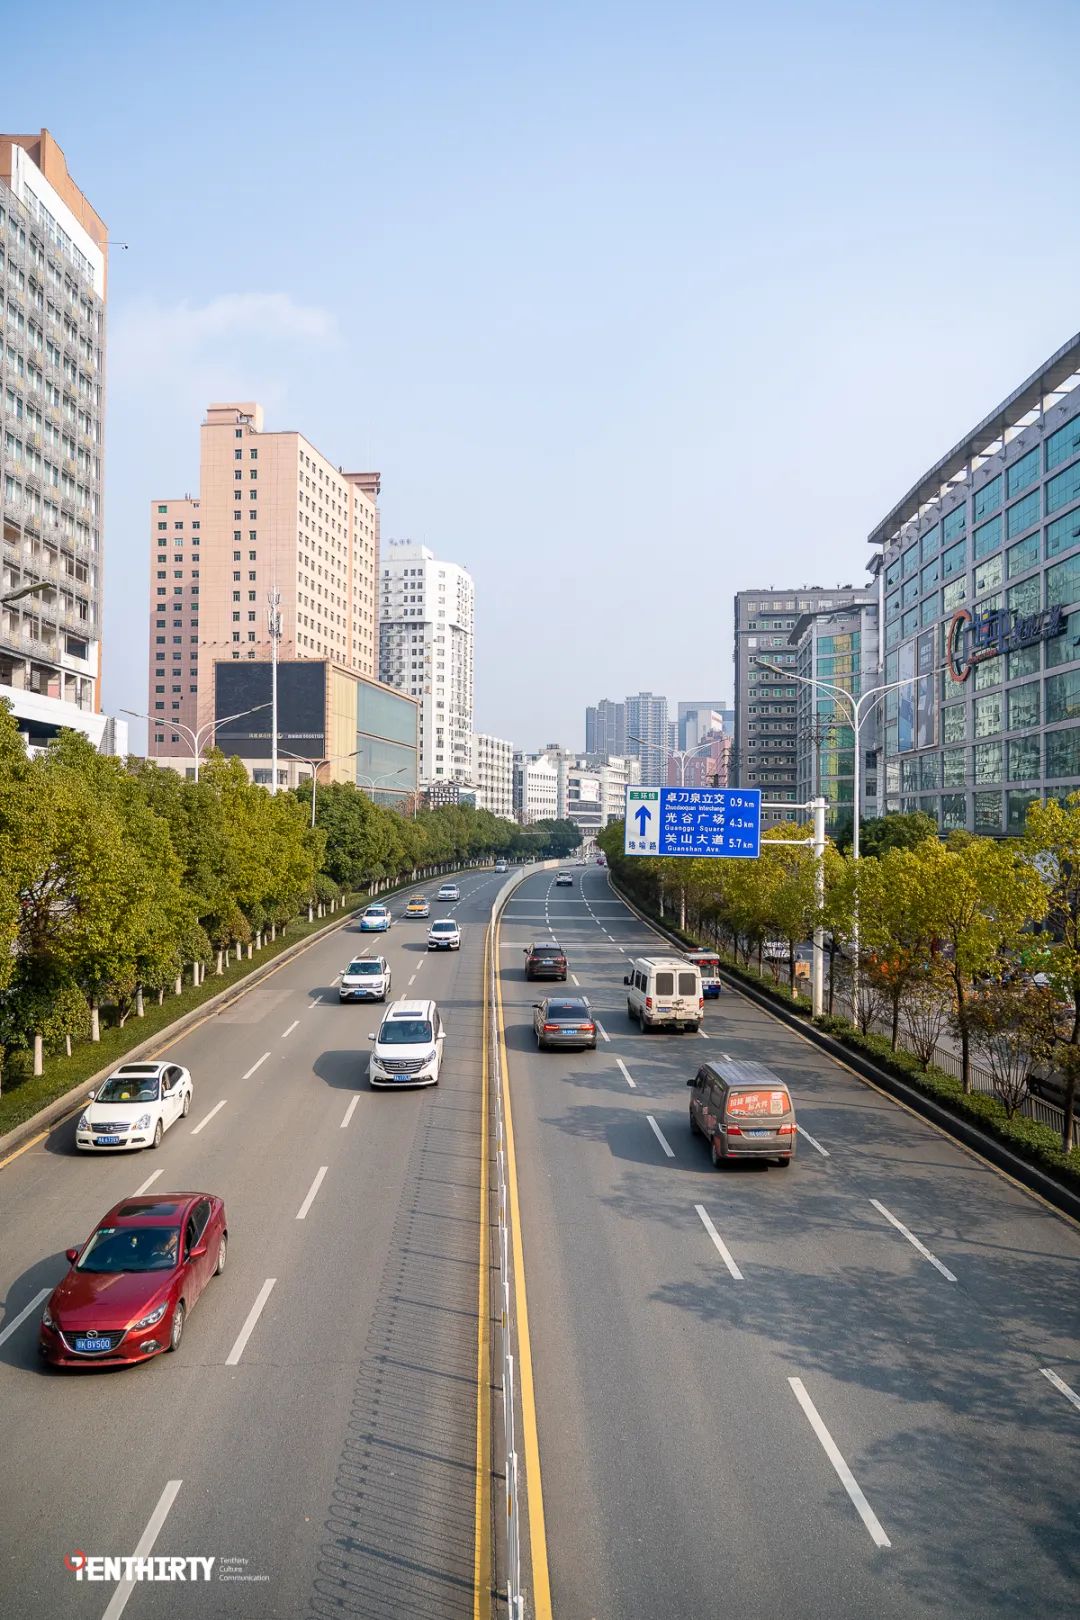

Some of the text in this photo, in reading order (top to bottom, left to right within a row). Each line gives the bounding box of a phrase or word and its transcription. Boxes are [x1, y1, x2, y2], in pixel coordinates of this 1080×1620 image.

[666, 792, 725, 804] 卓刀泉立交
[730, 798, 742, 807] 0.9
[665, 812, 725, 825] 光谷广场
[729, 818, 743, 828] 4.3
[664, 833, 724, 845] 关山大道
[728, 838, 753, 849] 5.7 km
